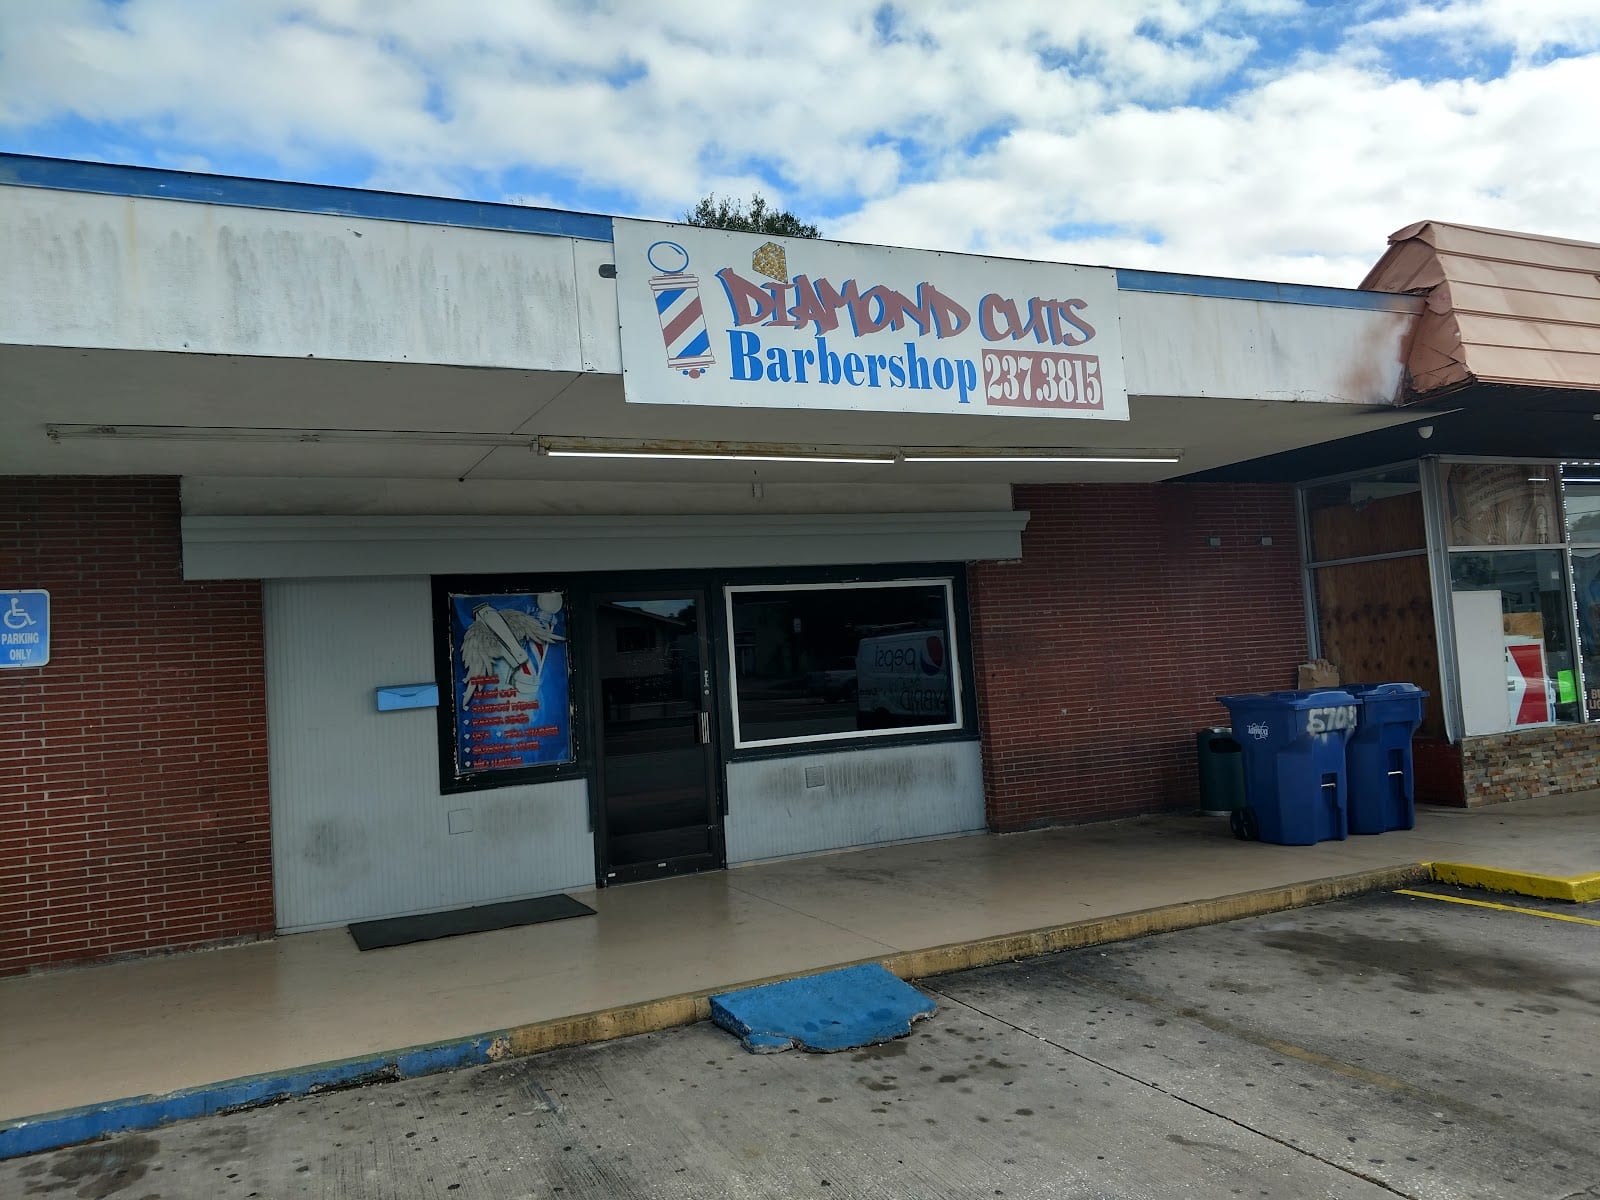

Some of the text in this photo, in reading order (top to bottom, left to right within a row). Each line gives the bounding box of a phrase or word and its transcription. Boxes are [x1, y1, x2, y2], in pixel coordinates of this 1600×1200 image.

[715, 267, 1096, 346] DIAMOND CUTS
[726, 329, 977, 403] Barbershop
[984, 353, 1103, 405] 237.3815
[2, 632, 39, 645] PARKING
[10, 649, 31, 660] ONLY
